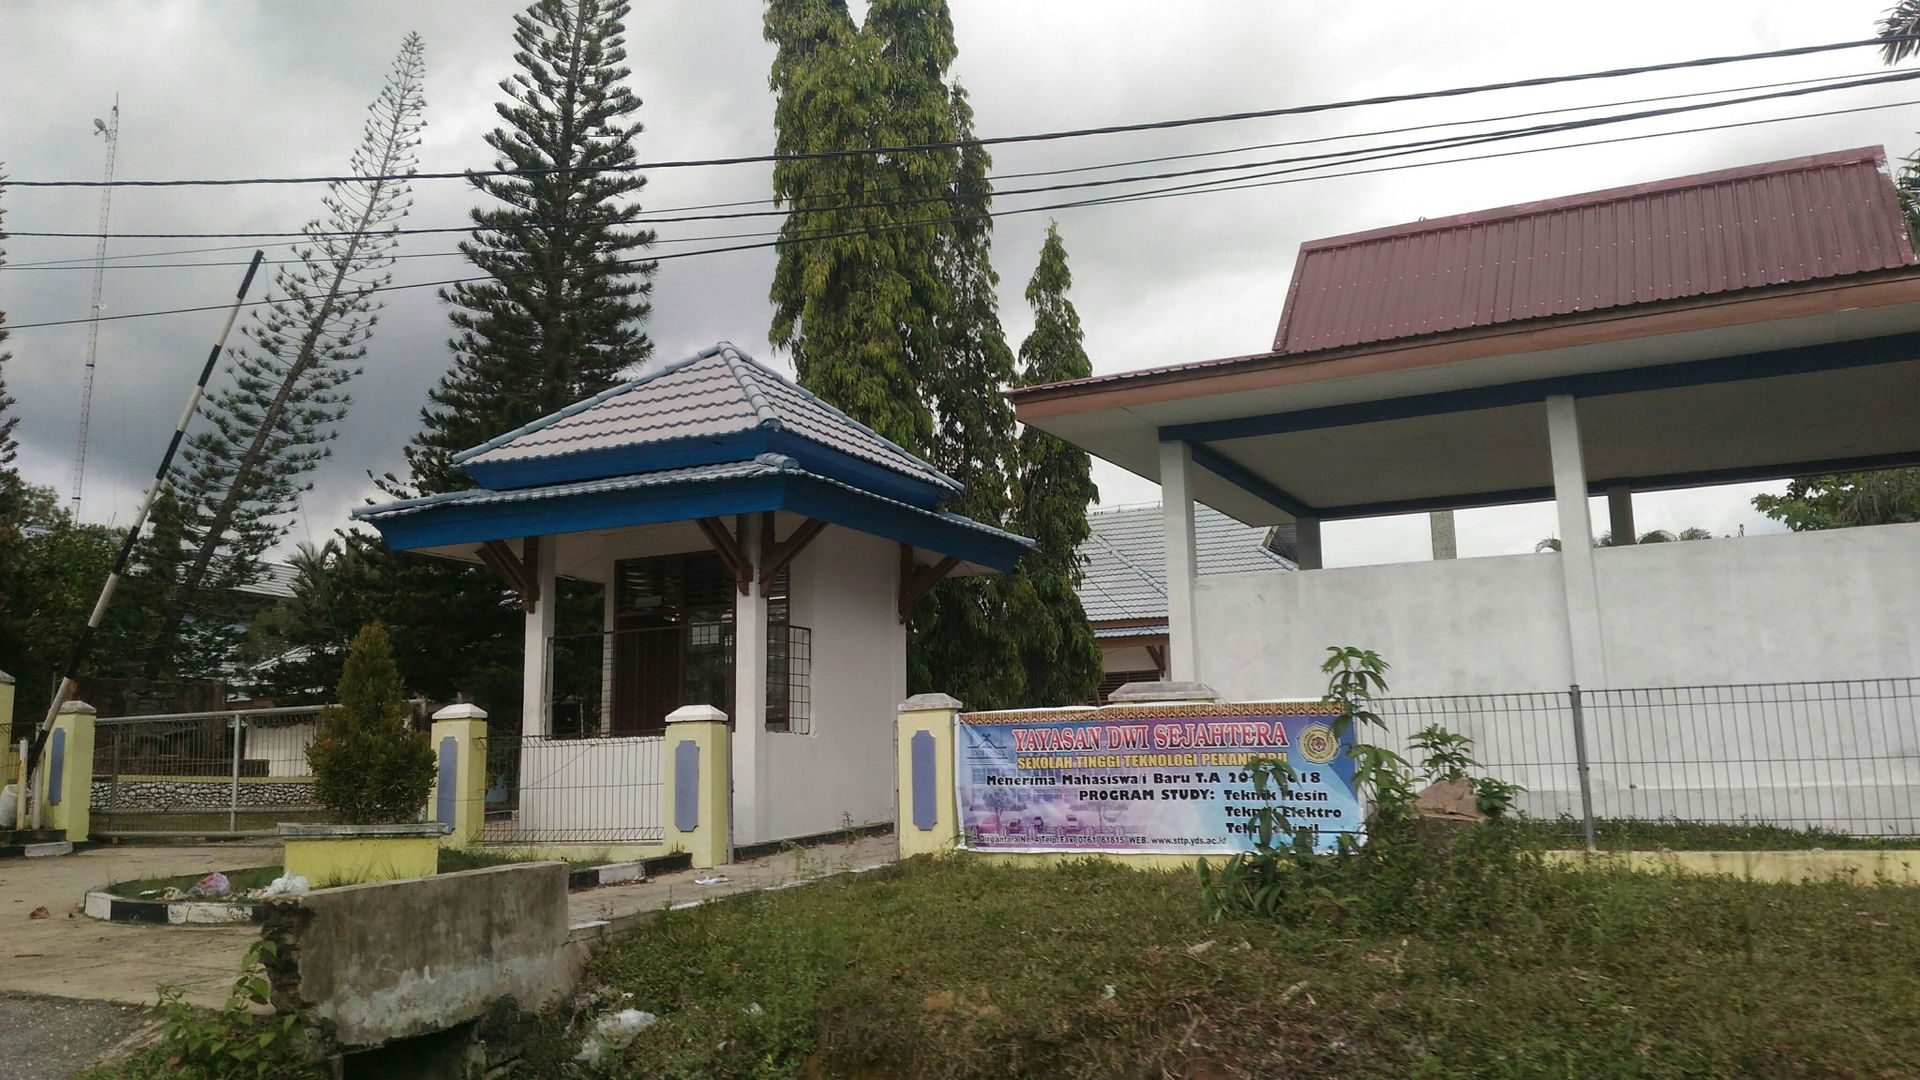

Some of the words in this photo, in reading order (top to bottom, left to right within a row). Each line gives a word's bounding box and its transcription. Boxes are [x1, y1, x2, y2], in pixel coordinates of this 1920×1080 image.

[1012, 726, 1102, 752] YAYASAN
[1106, 725, 1151, 750] DWI
[1153, 721, 1290, 750] SEJAHTERA
[1017, 757, 1074, 770] SEKOLAH
[1076, 755, 1122, 769] TINGGI
[1123, 753, 1198, 768] TEKNOLOGI
[986, 775, 1056, 786] Menerima
[1153, 772, 1190, 784] Baru
[1195, 772, 1221, 783] T.A
[1079, 789, 1154, 801] PROGRAM
[1161, 788, 1215, 800] STUDY:
[1282, 806, 1342, 819] Elektro
